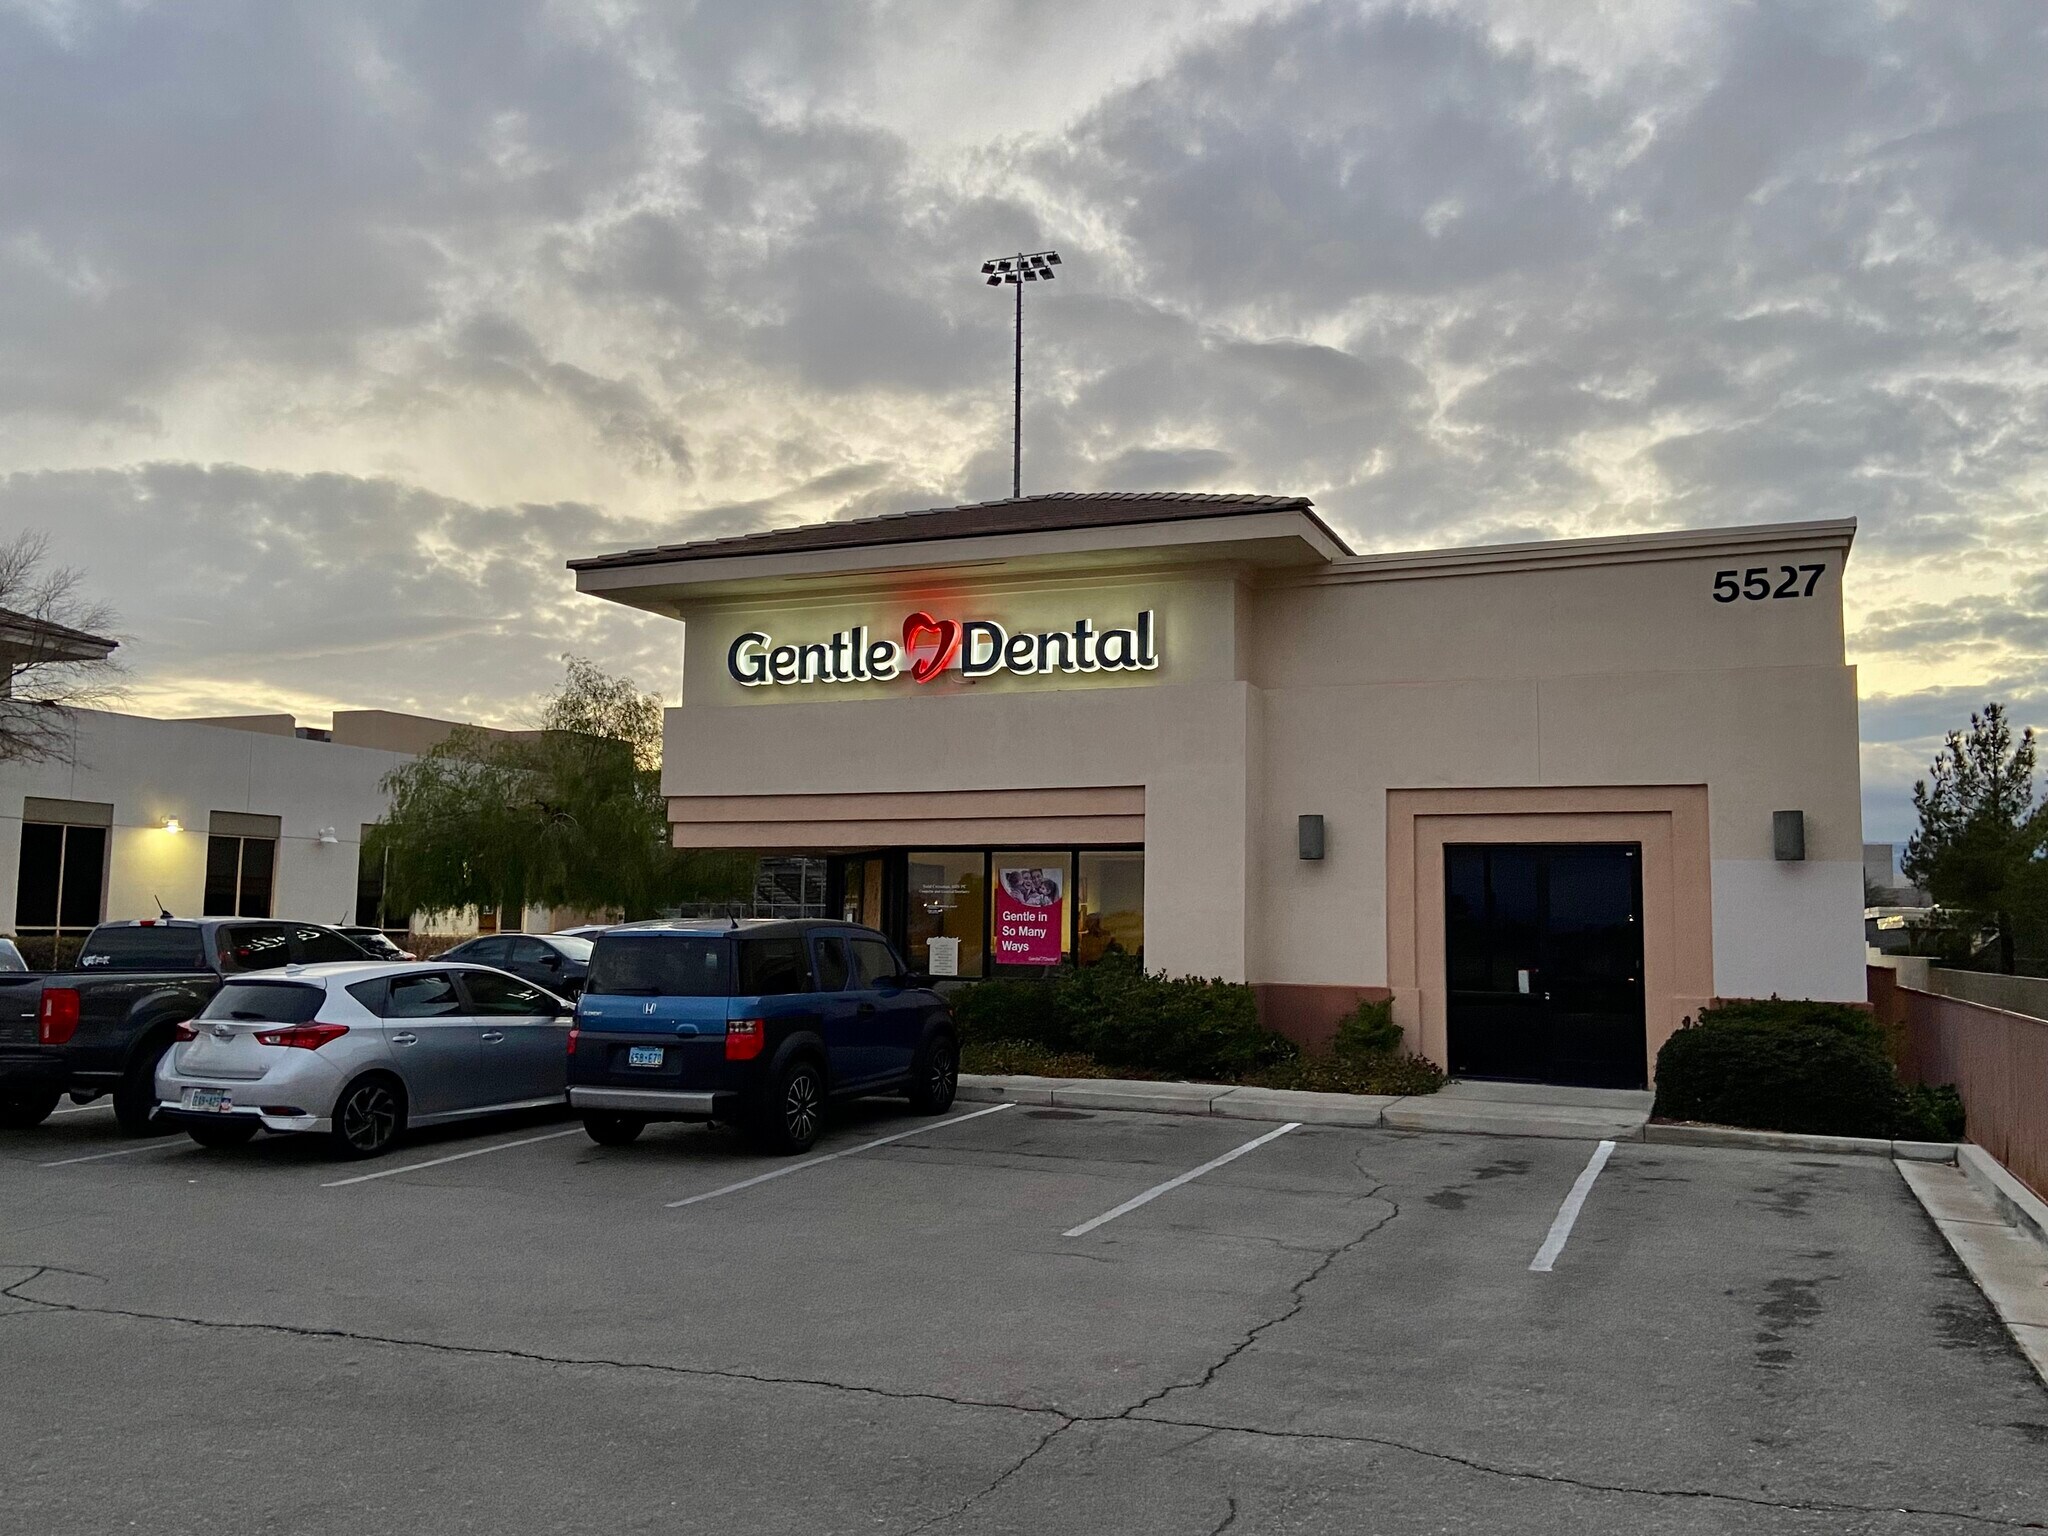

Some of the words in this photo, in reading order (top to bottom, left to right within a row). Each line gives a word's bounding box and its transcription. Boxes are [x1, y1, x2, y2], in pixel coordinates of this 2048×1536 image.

[1713, 564, 1825, 602] 5527
[727, 627, 898, 686] Gentle
[962, 610, 1158, 677] Dental
[1002, 911, 1035, 922] Gentle
[1038, 911, 1048, 922] in
[1002, 925, 1016, 936] So
[1018, 926, 1047, 939] Many
[1001, 940, 1029, 953] Ways
